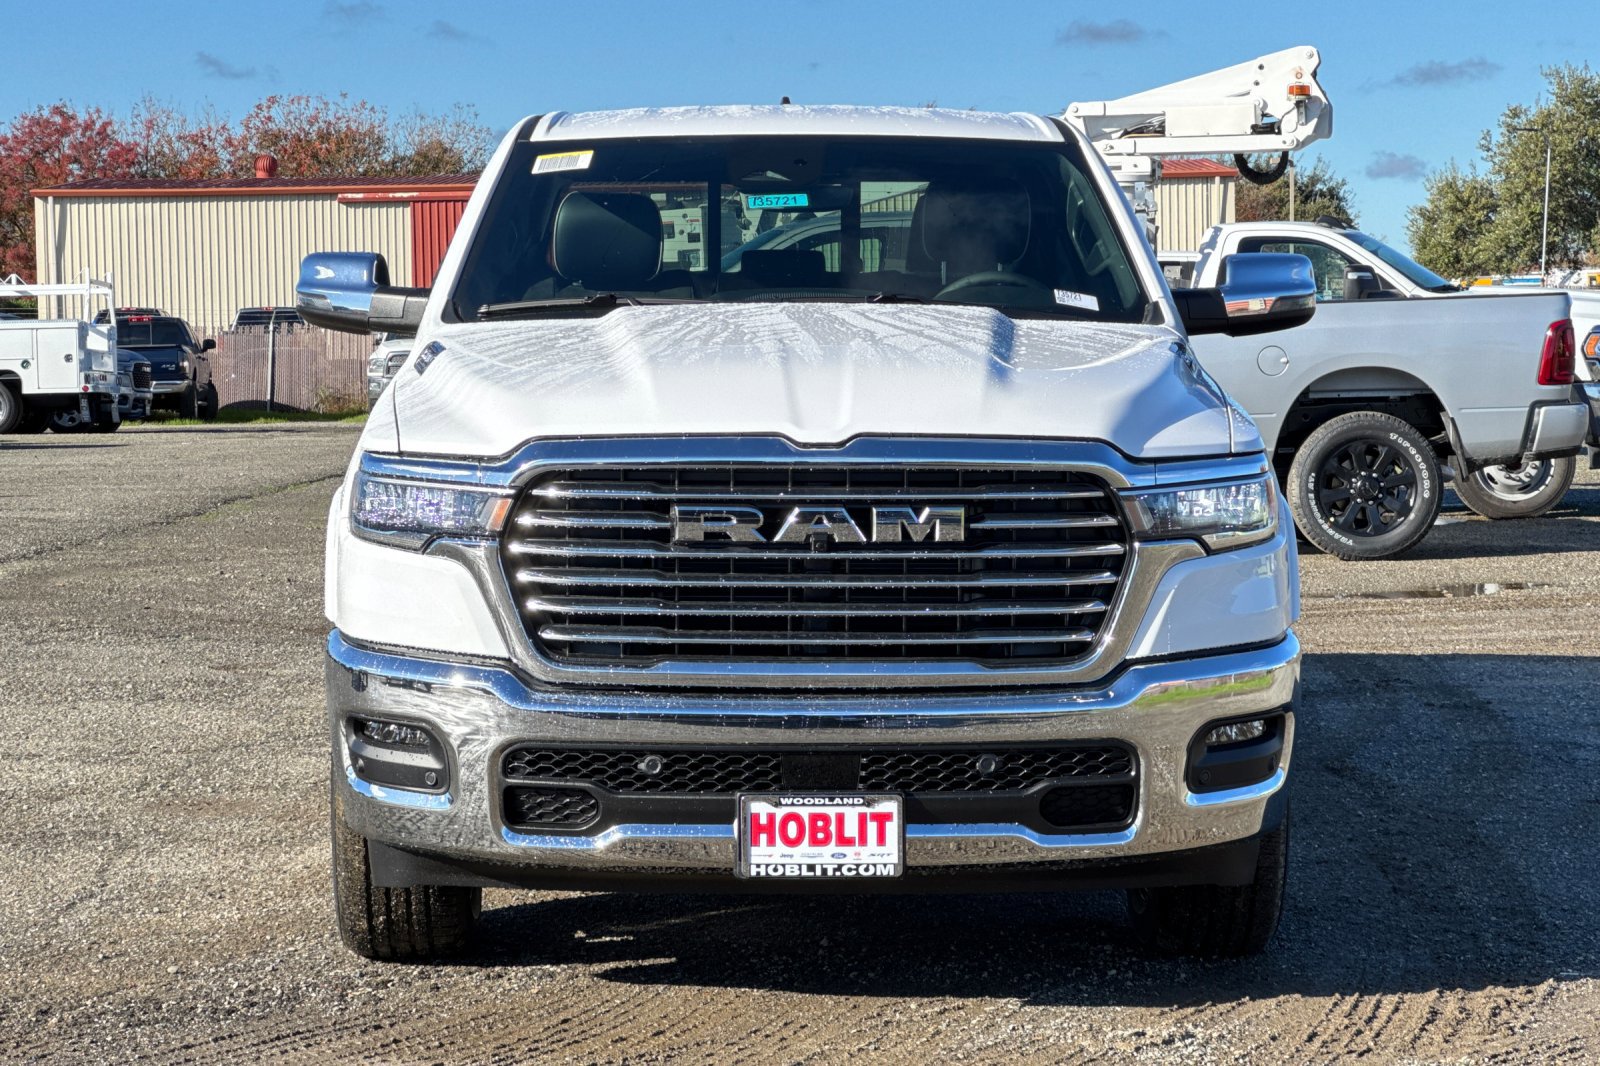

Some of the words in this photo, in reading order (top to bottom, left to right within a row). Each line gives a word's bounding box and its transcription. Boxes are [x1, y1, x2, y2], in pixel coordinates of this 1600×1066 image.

[671, 506, 965, 542] RAM
[779, 797, 864, 805] WOODLAND
[750, 811, 894, 848] HOBLIT
[750, 863, 895, 876] HOBLIT.COM
